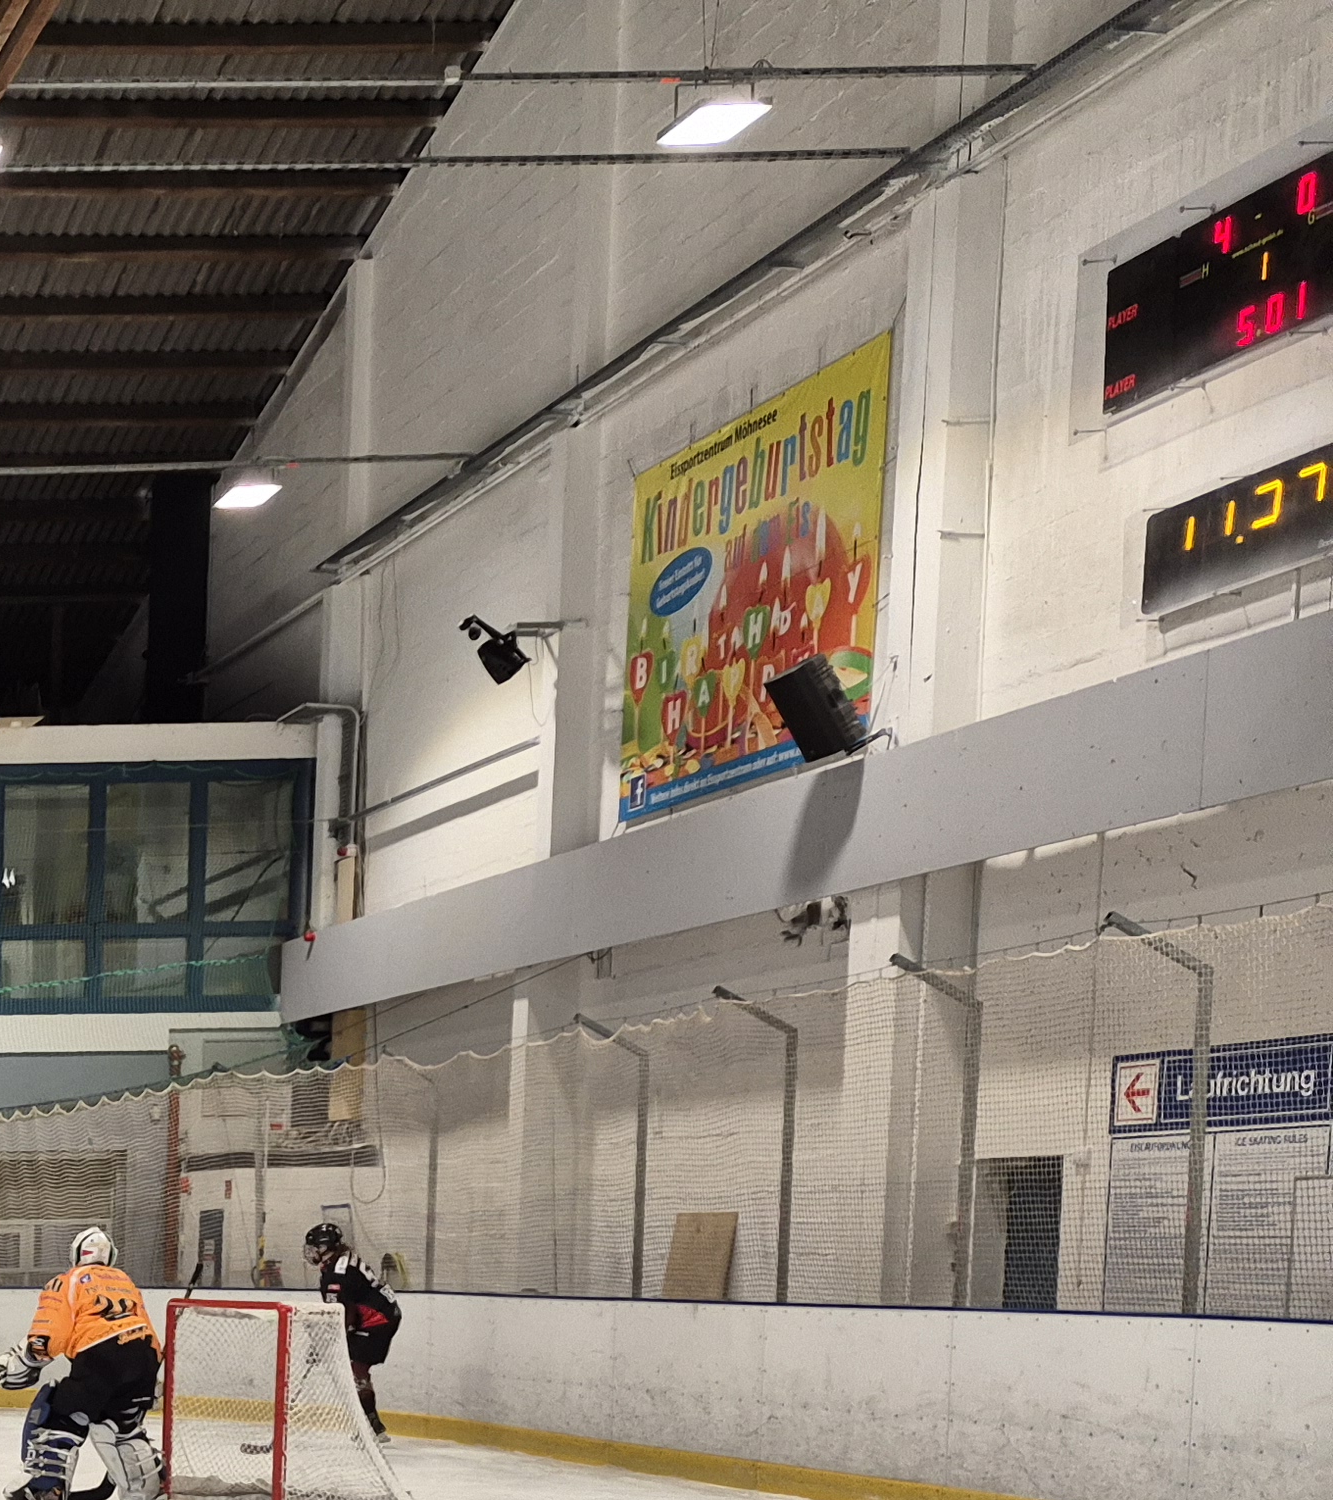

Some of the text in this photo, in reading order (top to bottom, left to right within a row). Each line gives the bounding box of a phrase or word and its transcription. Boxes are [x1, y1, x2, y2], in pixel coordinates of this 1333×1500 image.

[1213, 215, 1233, 254] 4
[1297, 171, 1317, 215] 0
[1108, 303, 1139, 331] PLAYER
[1105, 373, 1136, 401] PLAYER
[670, 409, 778, 480] Eissportzentrum Möhnesee
[642, 387, 871, 564] Kindergeburtstag
[1176, 1067, 1316, 1101] Lufrichtung
